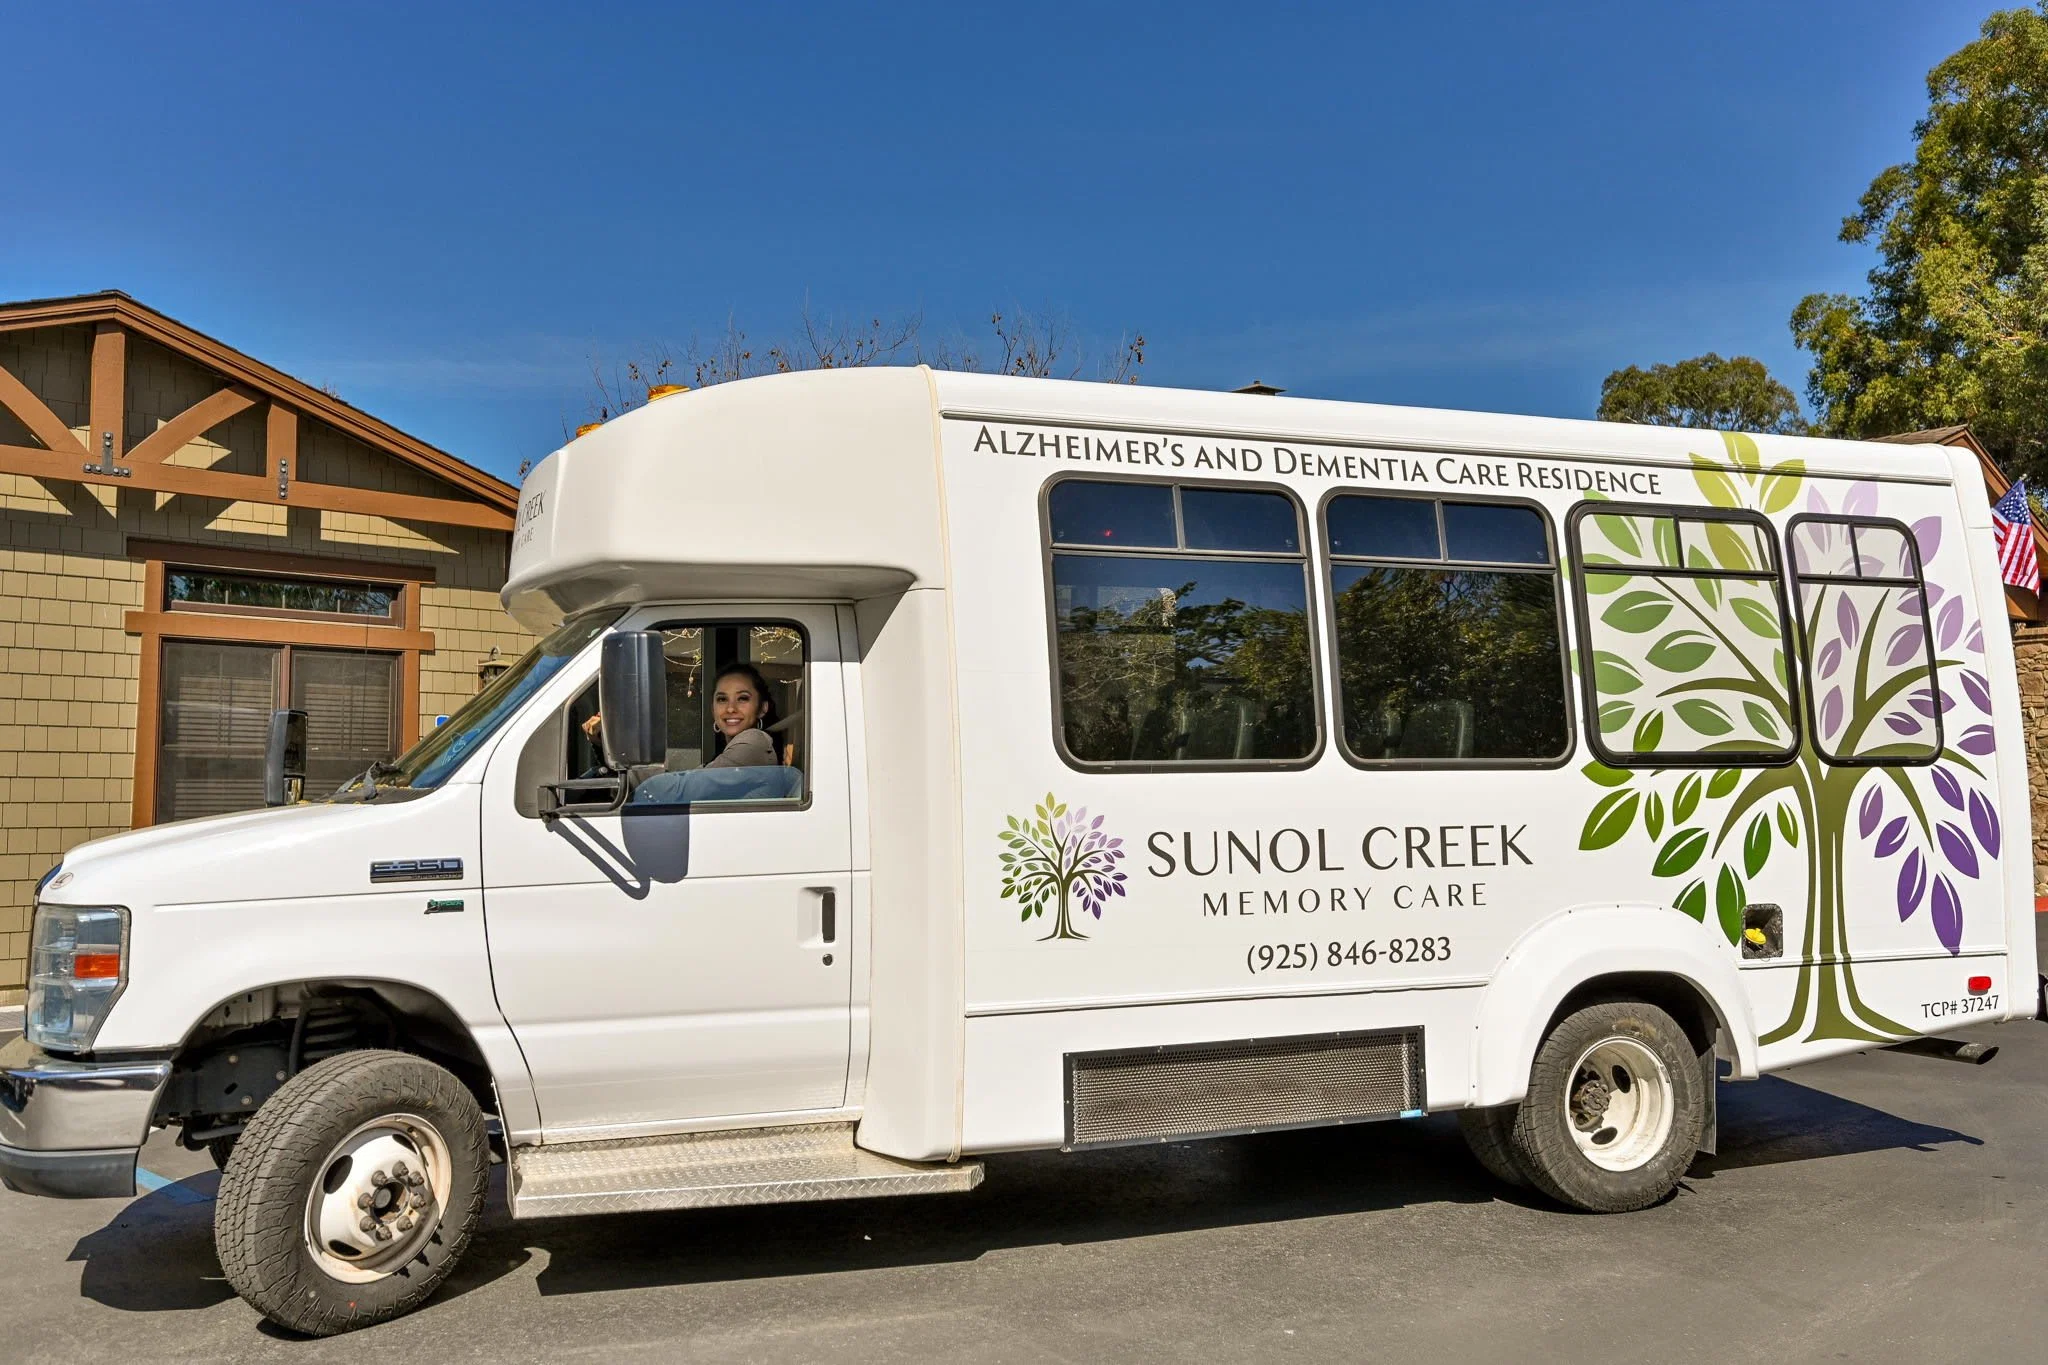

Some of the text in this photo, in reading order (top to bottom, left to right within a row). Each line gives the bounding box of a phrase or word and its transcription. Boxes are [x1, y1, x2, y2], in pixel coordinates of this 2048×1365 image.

[973, 424, 1662, 495] ALZHEIMER'S AND DEMENTIA CARE RESIDENCE
[1147, 824, 1534, 878] SUNOL CREEK
[1203, 883, 1487, 917] MEMORY CARE
[1247, 936, 1452, 975] (925) 846-8283
[1921, 995, 1999, 1018] TCP# 37247
